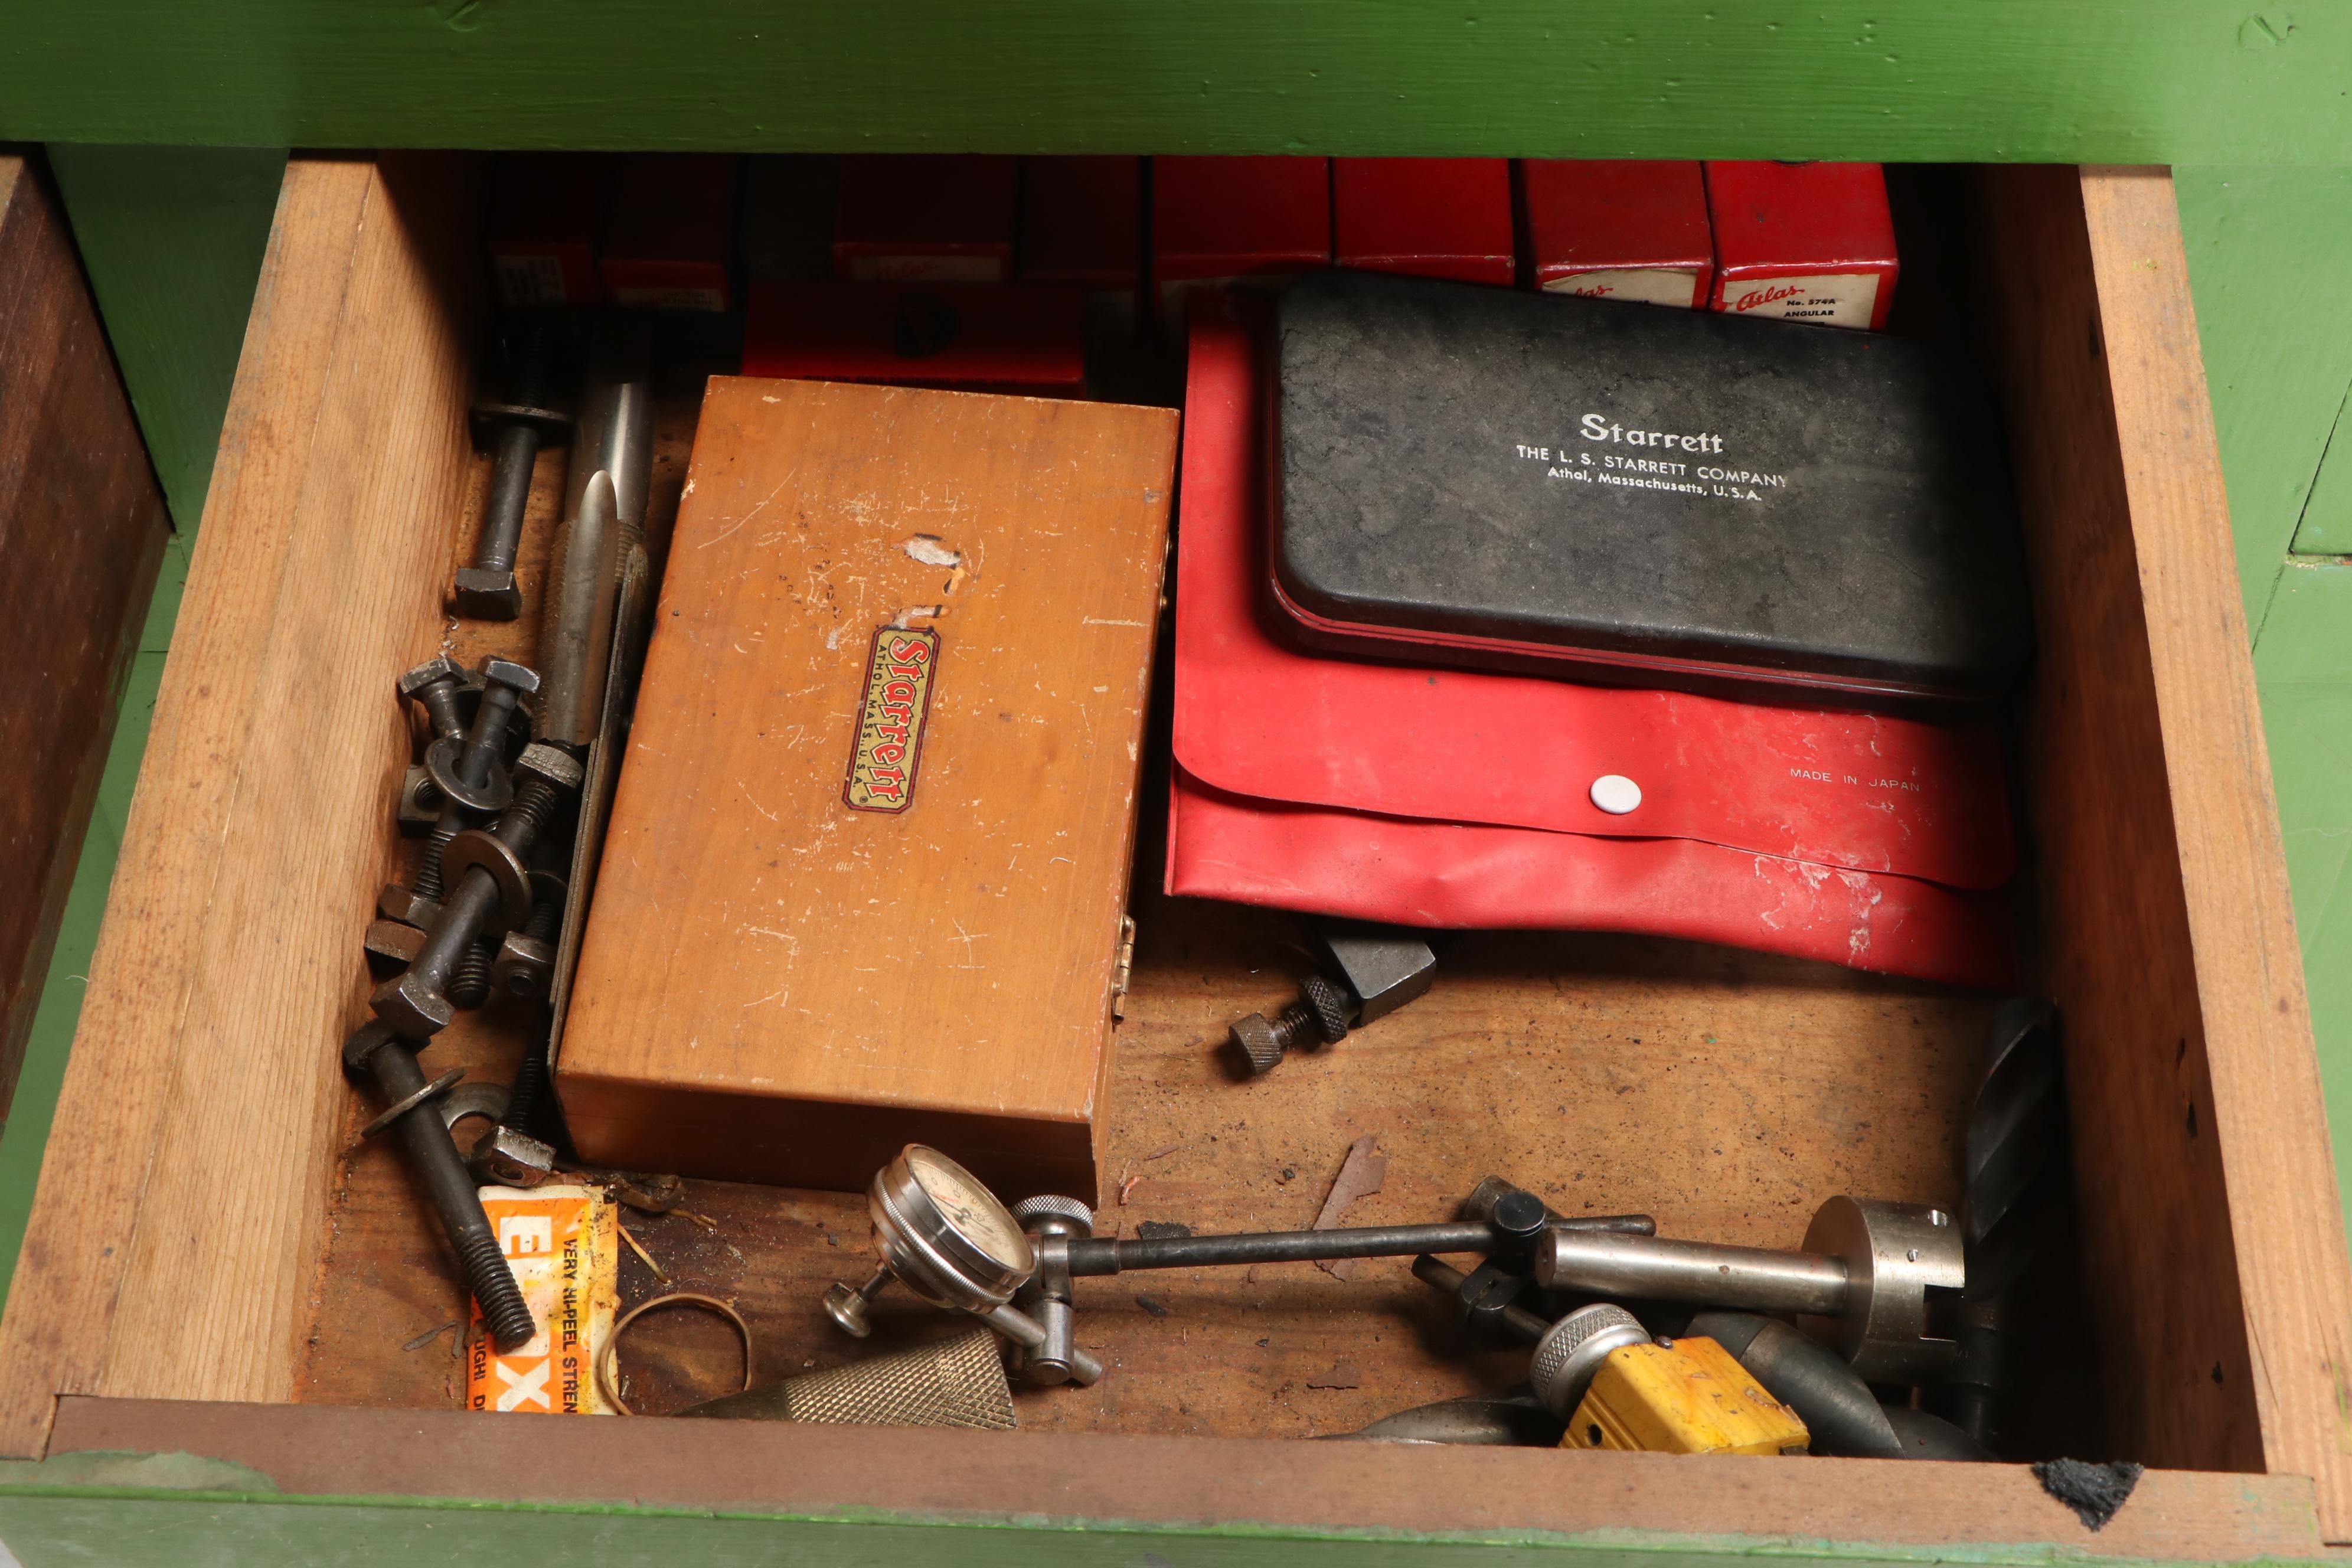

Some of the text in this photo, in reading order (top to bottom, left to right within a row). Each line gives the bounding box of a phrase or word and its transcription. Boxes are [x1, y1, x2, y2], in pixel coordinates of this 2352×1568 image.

[1736, 285, 1805, 312] Atlas
[1580, 413, 1723, 454] Starrett
[1516, 445, 1786, 488] THE L. S. STARRETT COMPANY
[1547, 465, 1592, 484] Athol,
[1598, 472, 1707, 496] Massachusetts,
[870, 644, 887, 695] ATHOL,
[864, 636, 930, 803] Starrett
[1790, 768, 1920, 792] MADE IN JAPAN
[563, 1239, 577, 1282] VERY
[562, 1287, 577, 1352] HI-PEEL
